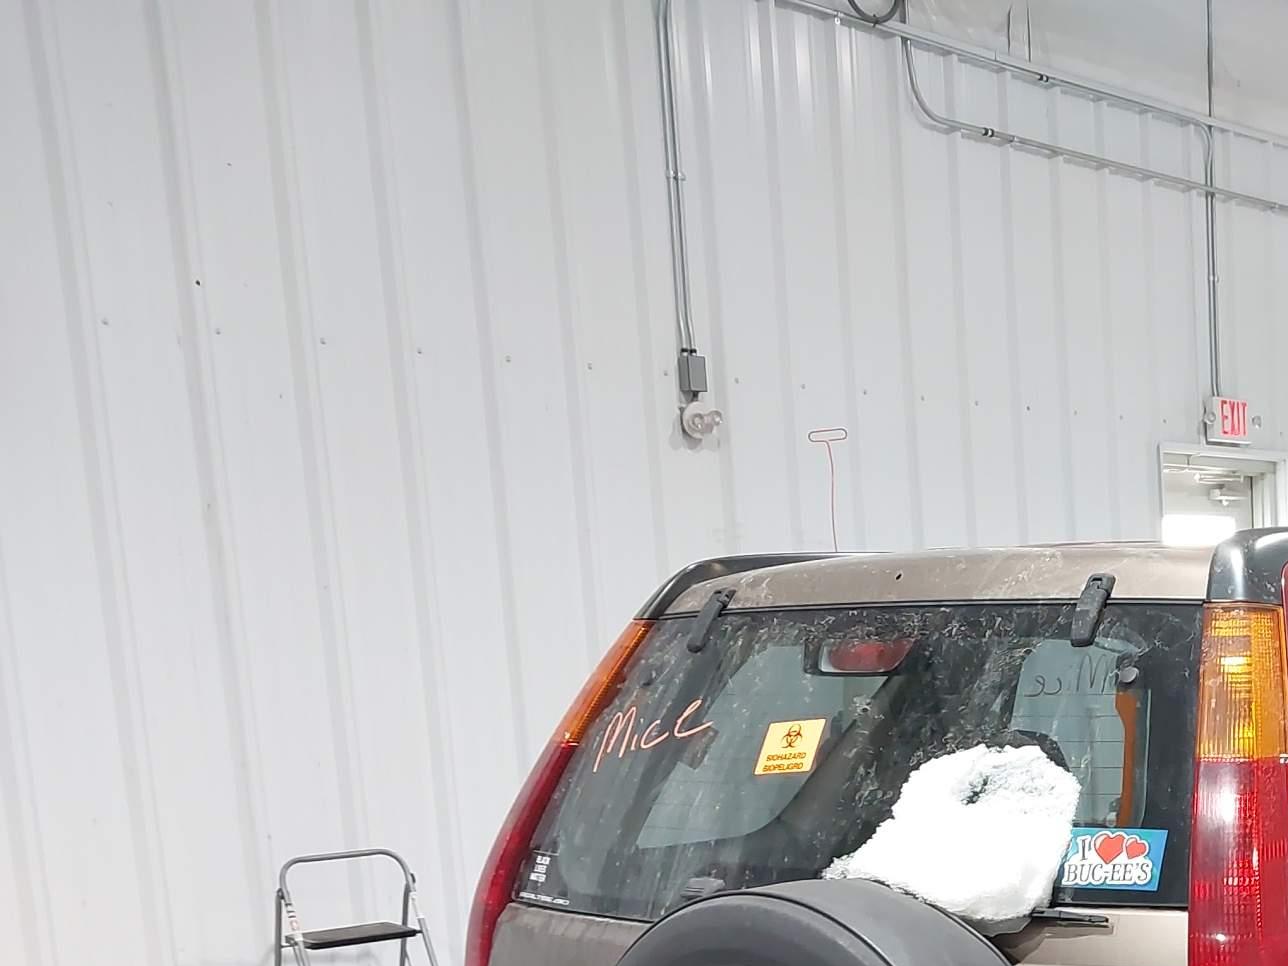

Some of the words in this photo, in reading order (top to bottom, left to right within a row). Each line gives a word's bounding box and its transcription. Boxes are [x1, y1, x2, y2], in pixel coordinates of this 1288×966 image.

[1221, 399, 1248, 436] EXIT
[766, 752, 806, 761] BIOHAZARD
[1066, 862, 1149, 883] BUC-EE'S
